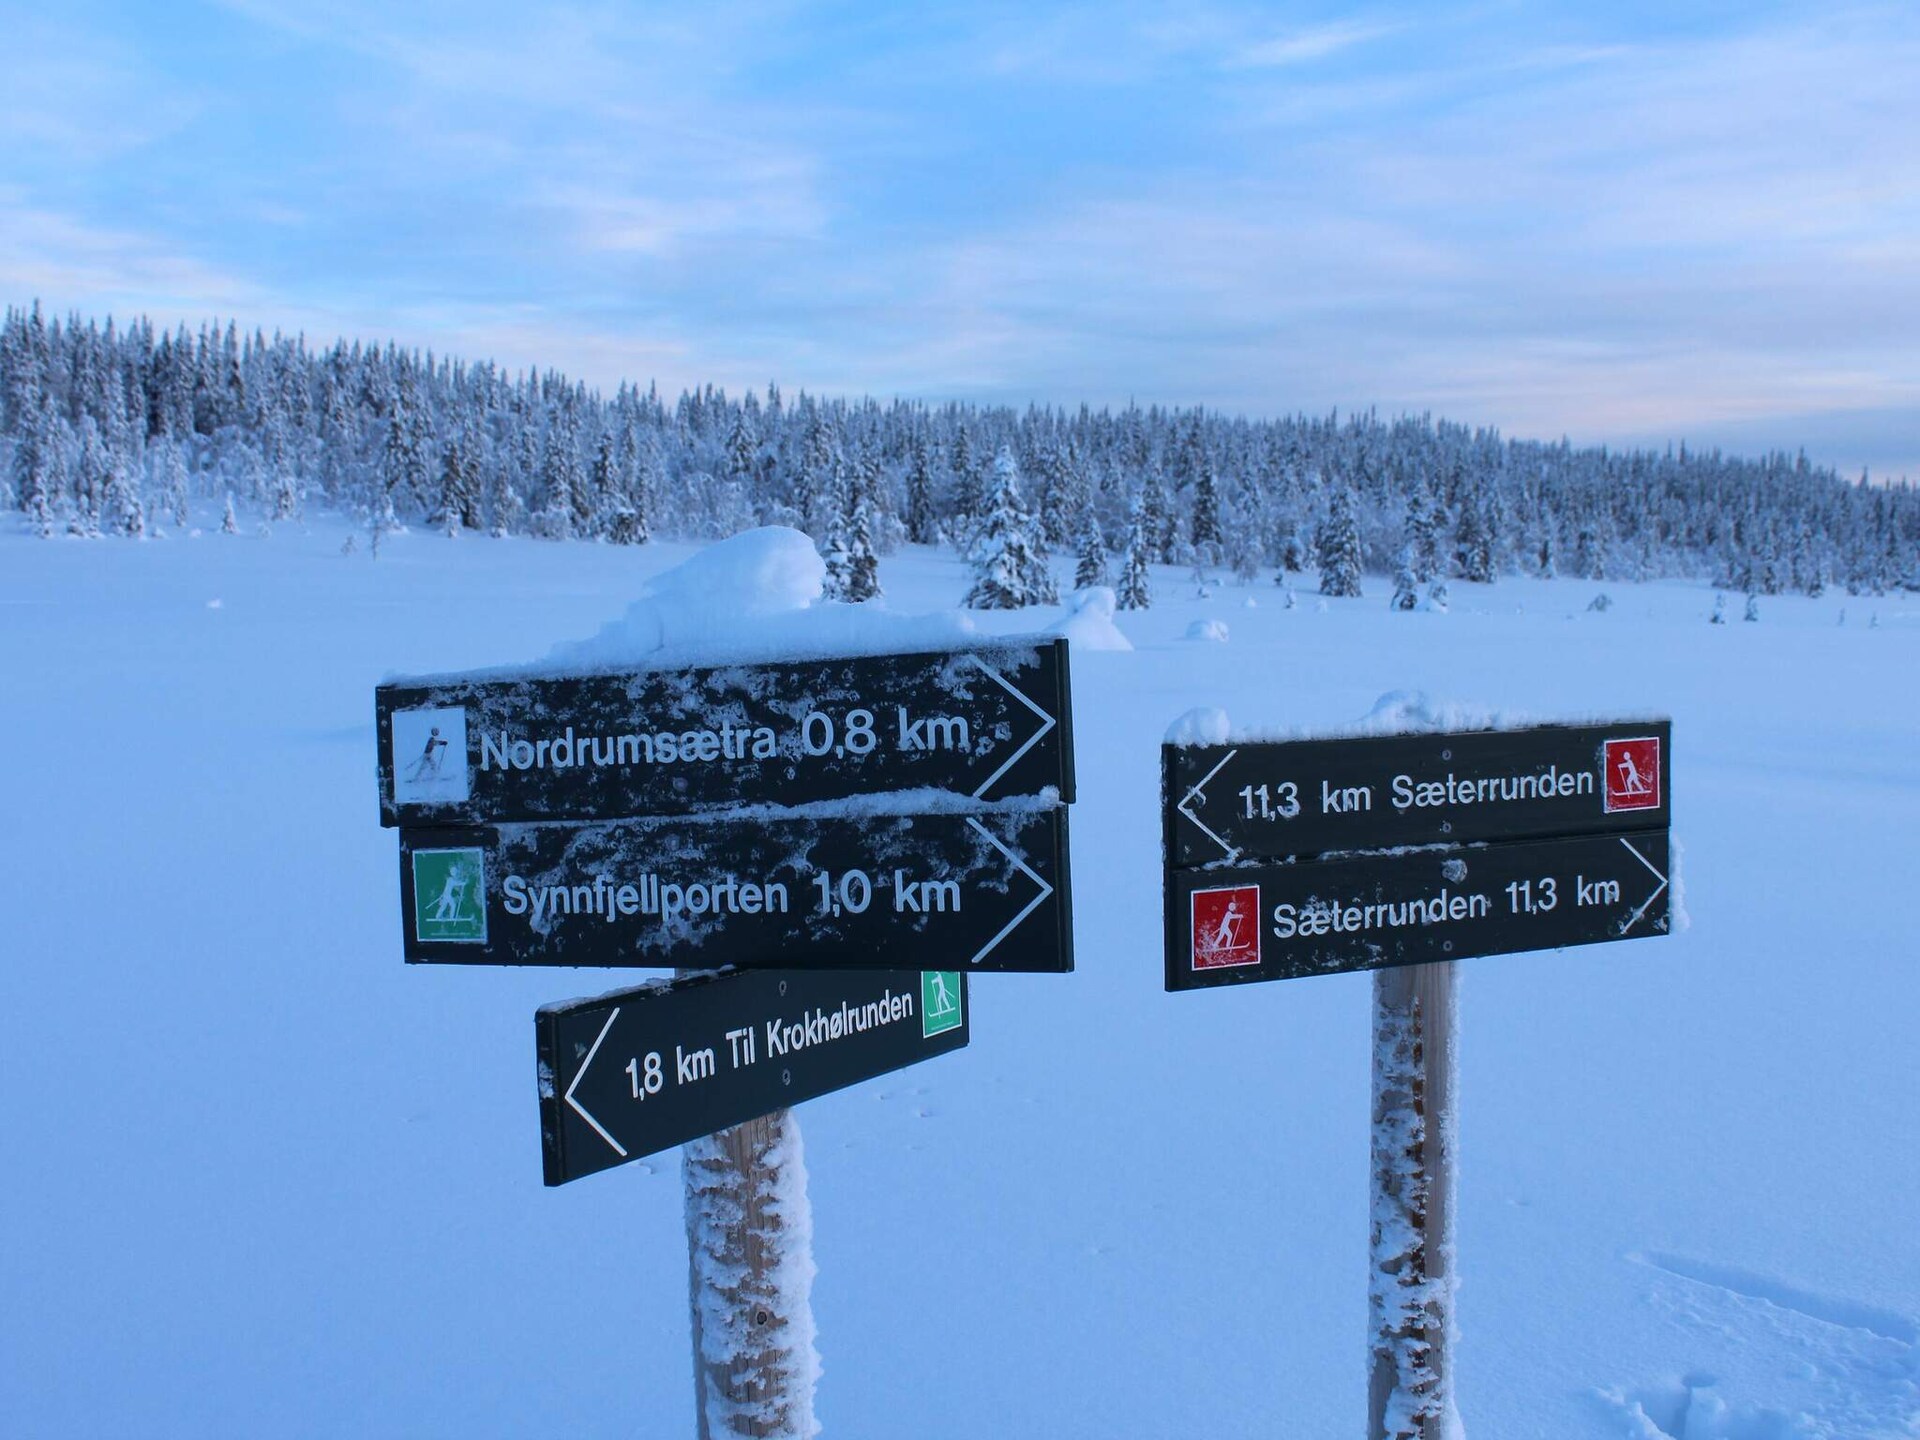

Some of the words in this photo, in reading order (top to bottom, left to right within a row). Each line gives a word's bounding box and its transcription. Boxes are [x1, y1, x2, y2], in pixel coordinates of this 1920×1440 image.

[481, 726, 777, 771] Nordrumsætra
[802, 708, 877, 759] 0,8
[900, 707, 970, 751] km
[1239, 781, 1300, 822] 11,3
[1323, 780, 1371, 813] km
[1392, 765, 1593, 808] Sæterrunden
[503, 874, 788, 920] Synnfjellporten
[813, 869, 872, 918] 1,0
[895, 869, 961, 912] km
[1273, 888, 1487, 939] Sæterrunden
[1506, 877, 1557, 914] 11,3
[1577, 875, 1620, 906] km
[625, 1052, 663, 1101] 1,8
[677, 1046, 715, 1085] km
[726, 1026, 755, 1069] Til
[766, 989, 913, 1058] Krokhølrunden
